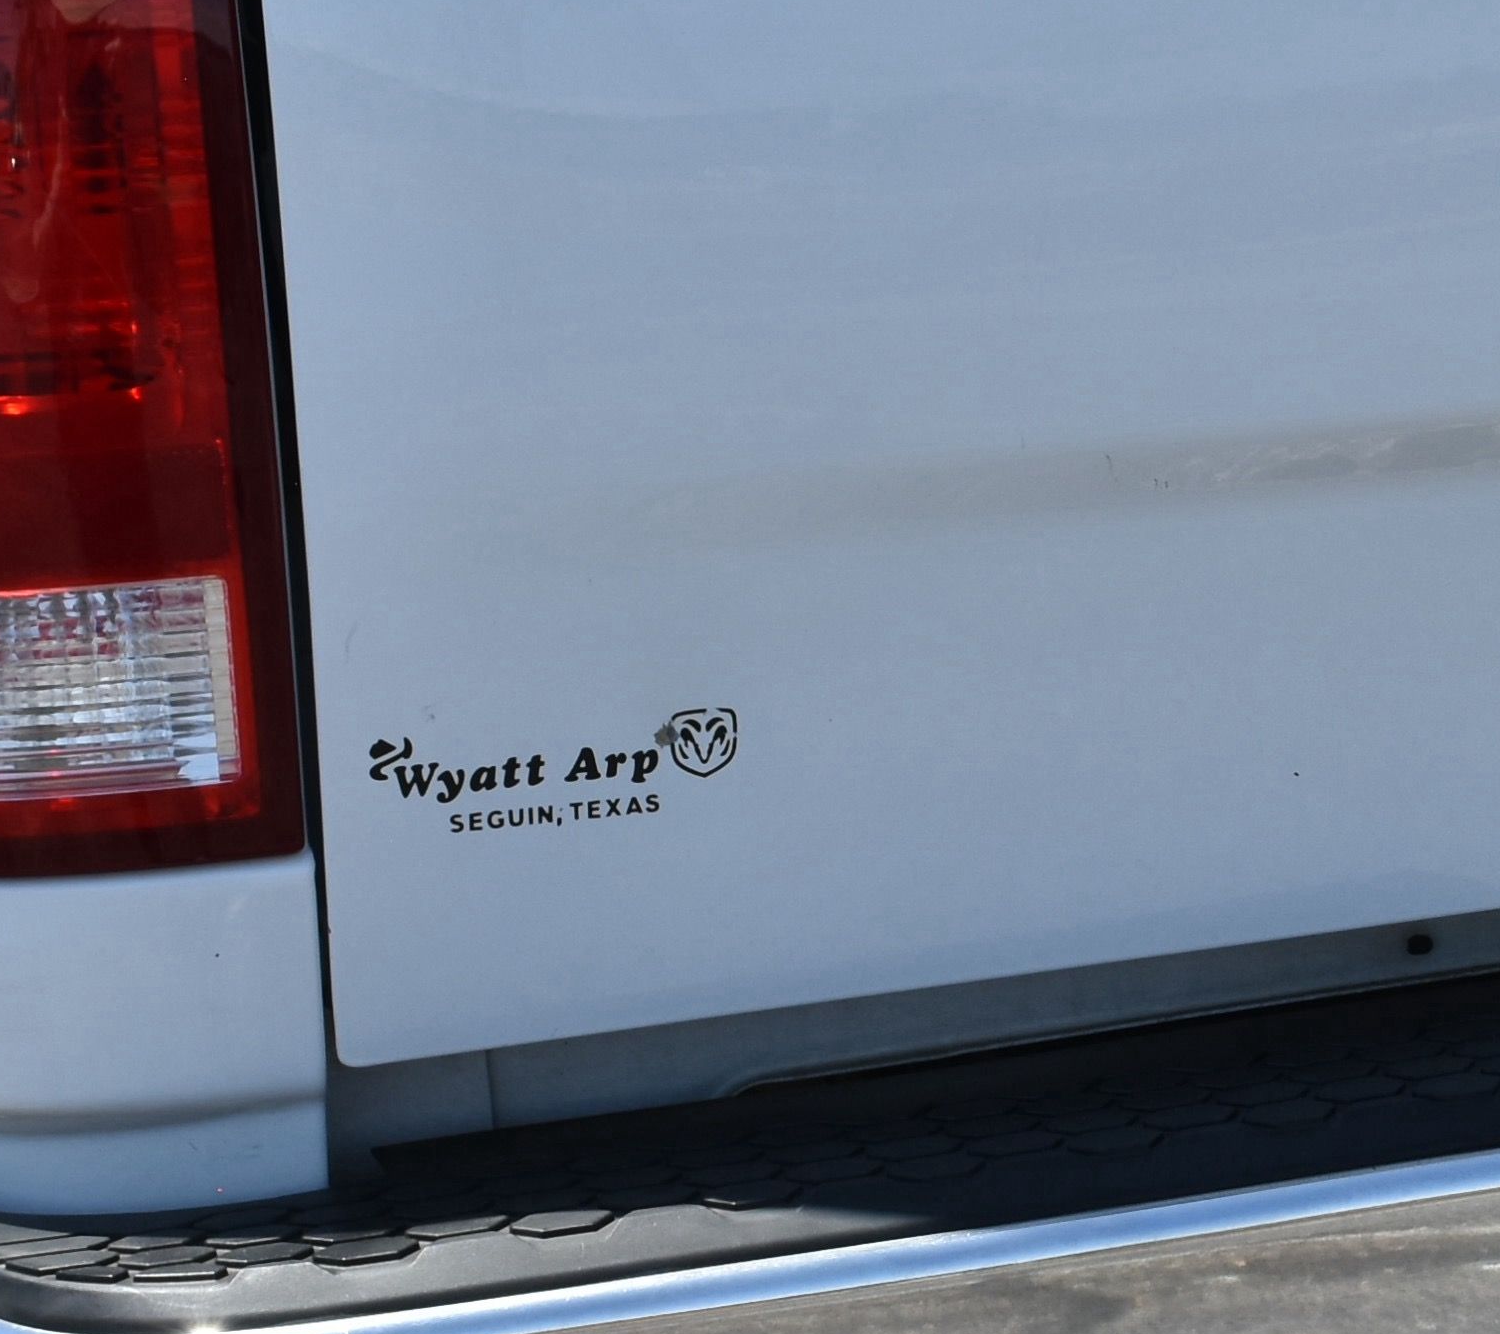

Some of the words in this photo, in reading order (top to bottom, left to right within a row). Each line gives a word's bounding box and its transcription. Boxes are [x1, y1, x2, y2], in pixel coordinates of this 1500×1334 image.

[369, 749, 546, 804] Wyatt
[564, 747, 659, 783] Arp
[569, 794, 661, 821] TEXAS
